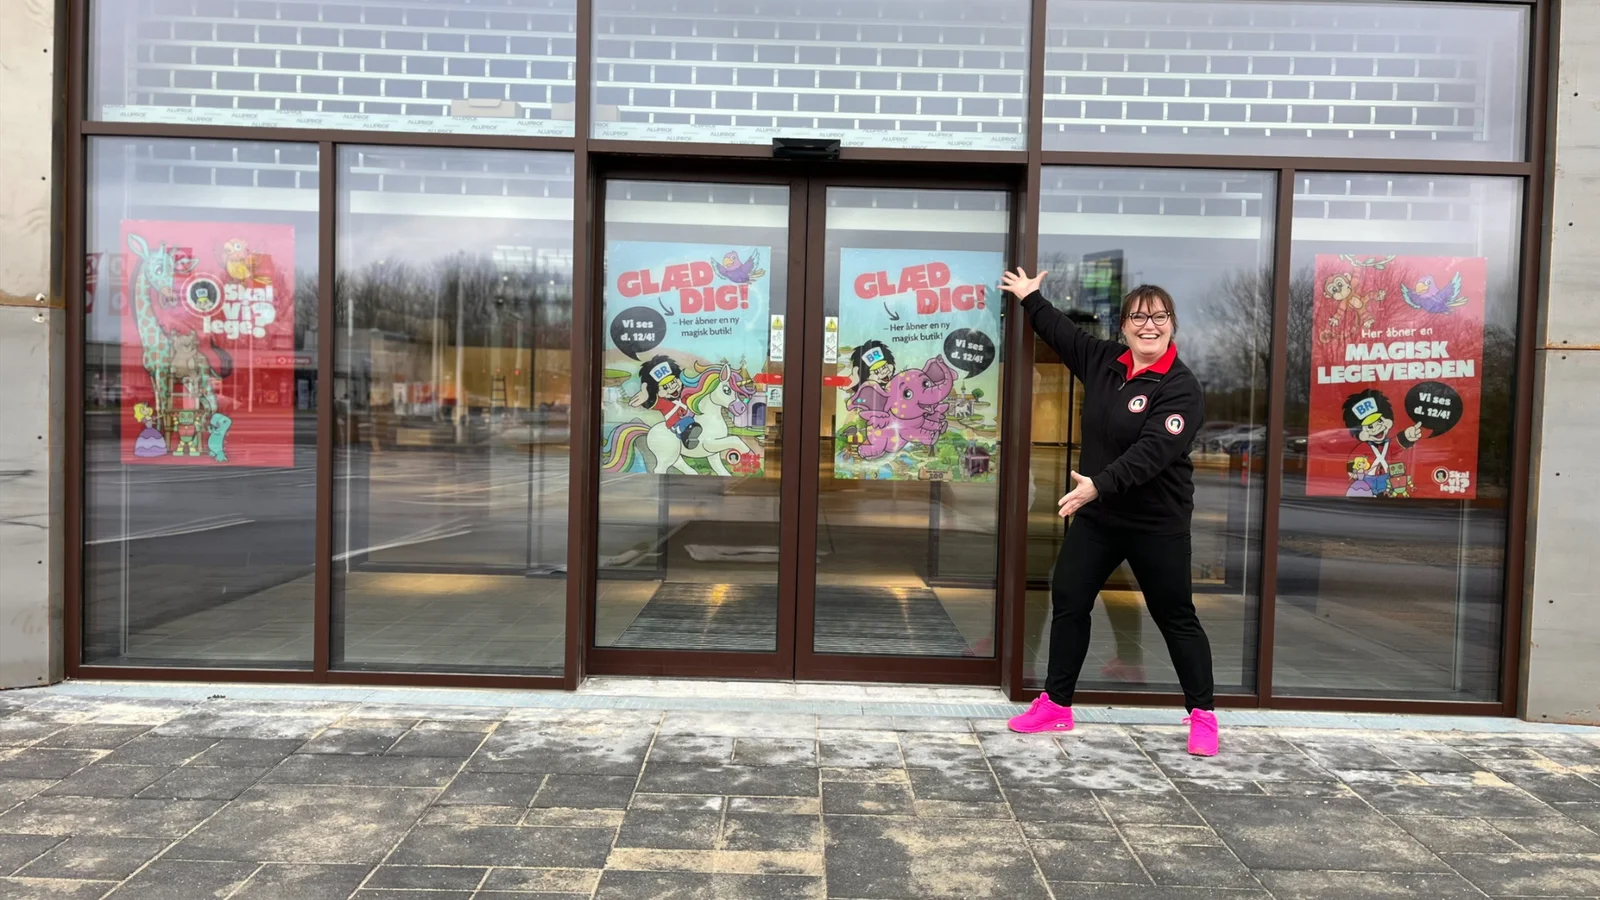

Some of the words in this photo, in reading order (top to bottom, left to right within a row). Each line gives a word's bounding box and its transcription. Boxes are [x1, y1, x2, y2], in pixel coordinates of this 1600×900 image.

[617, 261, 714, 298] GLÆD
[854, 261, 951, 299] GLÆD
[224, 284, 274, 302] Skal
[679, 284, 749, 314] DIG!
[916, 285, 986, 315] DIG!
[622, 319, 634, 328] Vi
[636, 321, 653, 329] ses
[679, 318, 693, 326] Her
[696, 316, 716, 325] åbner
[731, 317, 740, 326] ny
[905, 322, 927, 330] åbner
[941, 322, 950, 332] ny
[620, 333, 630, 341] d.
[632, 332, 656, 341] 12/4!
[681, 329, 708, 338] magisk
[709, 327, 732, 336] butik!
[892, 335, 918, 343] magisk
[920, 332, 943, 341] butik!
[1361, 329, 1382, 339] Her
[1385, 326, 1416, 337] åbner
[1420, 327, 1433, 336] en
[955, 339, 966, 347] Vi
[967, 342, 984, 351] ses
[1344, 340, 1450, 362] MAGISK
[865, 350, 882, 363] BR
[951, 350, 960, 359] d.
[962, 352, 984, 363] 12/4!
[653, 365, 671, 380] BR
[1317, 359, 1476, 385] LEGEVERDEN
[1418, 392, 1431, 402] Vi
[1432, 396, 1451, 406] ses
[1356, 401, 1375, 416] BR
[1413, 405, 1424, 416] d.
[1427, 407, 1451, 420] 12/4!
